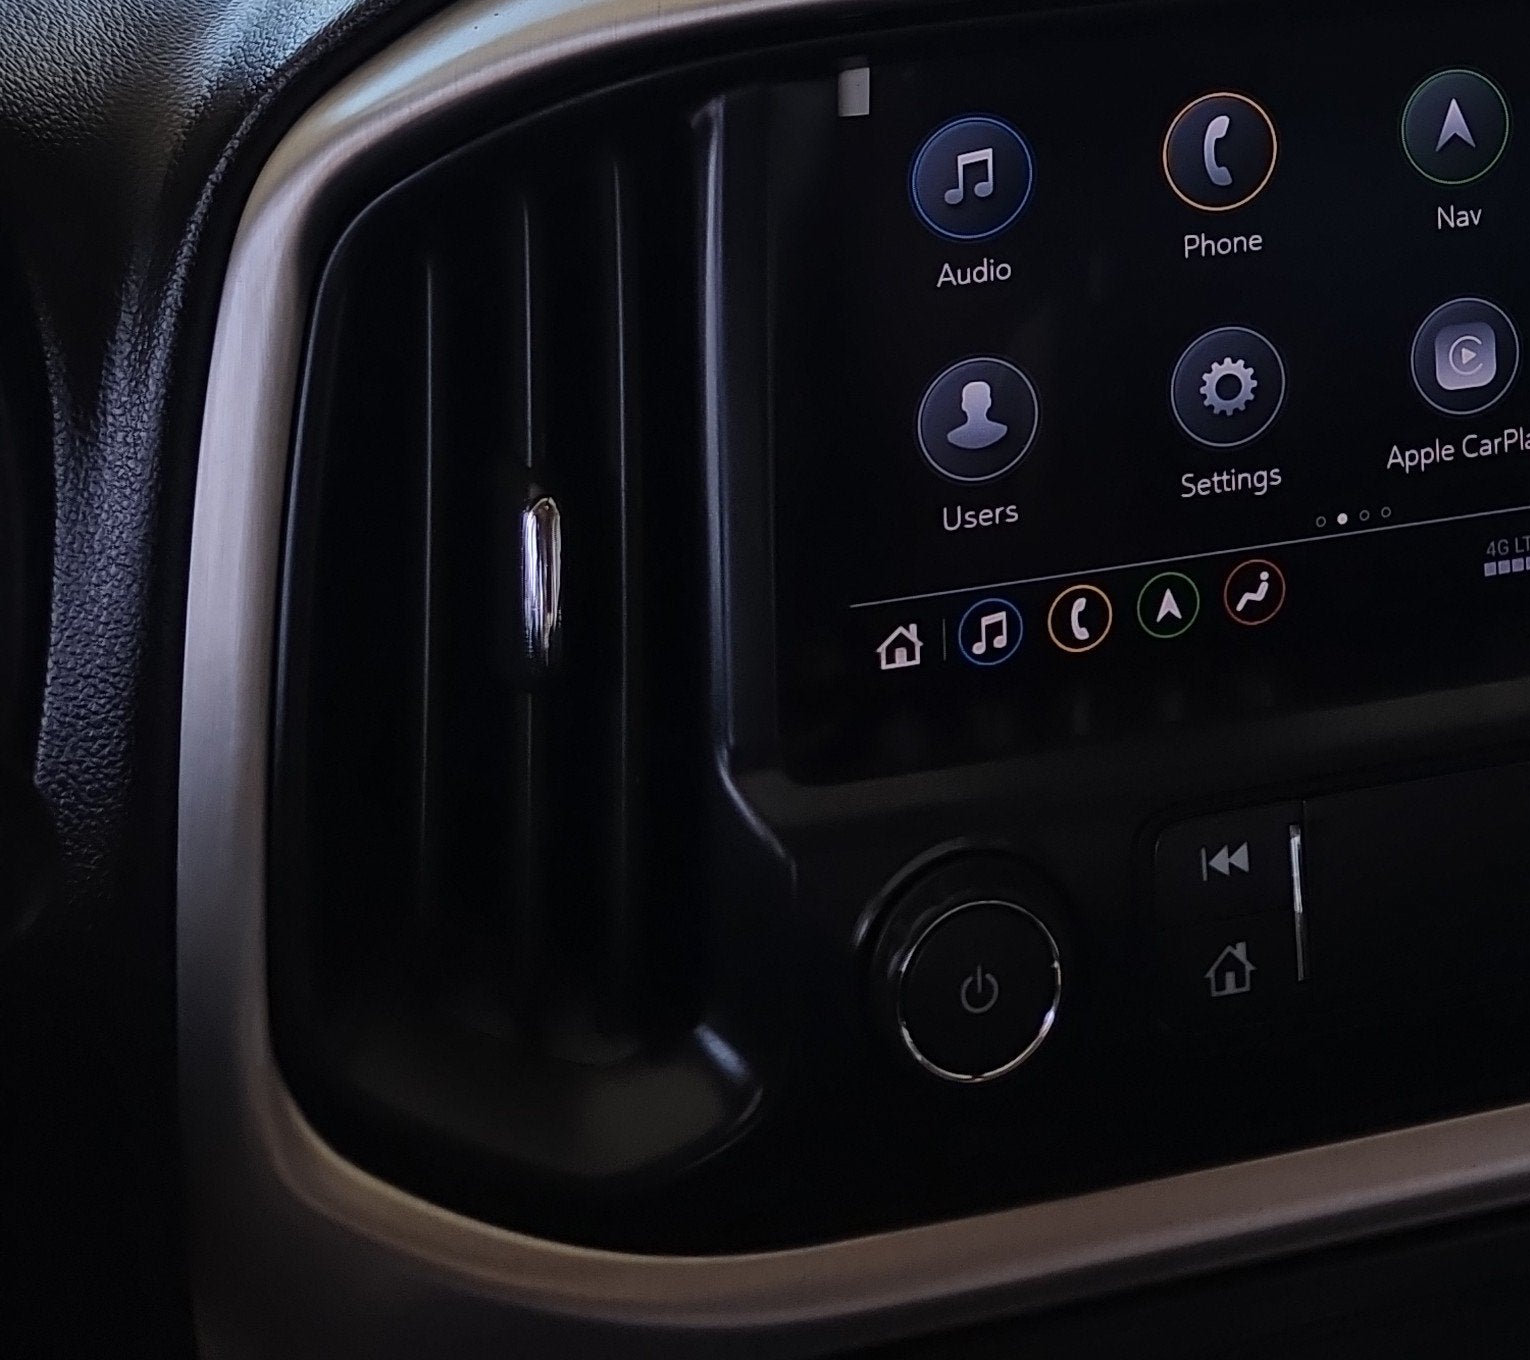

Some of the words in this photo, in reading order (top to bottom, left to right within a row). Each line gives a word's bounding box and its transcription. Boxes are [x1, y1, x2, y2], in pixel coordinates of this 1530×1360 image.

[1437, 206, 1483, 230] Nav
[1183, 233, 1263, 259] Phone
[936, 257, 1012, 288] Audio
[1386, 438, 1455, 474] Apple
[1180, 467, 1282, 498] Settings
[942, 503, 1019, 531] Users
[1486, 537, 1510, 557] 4G
